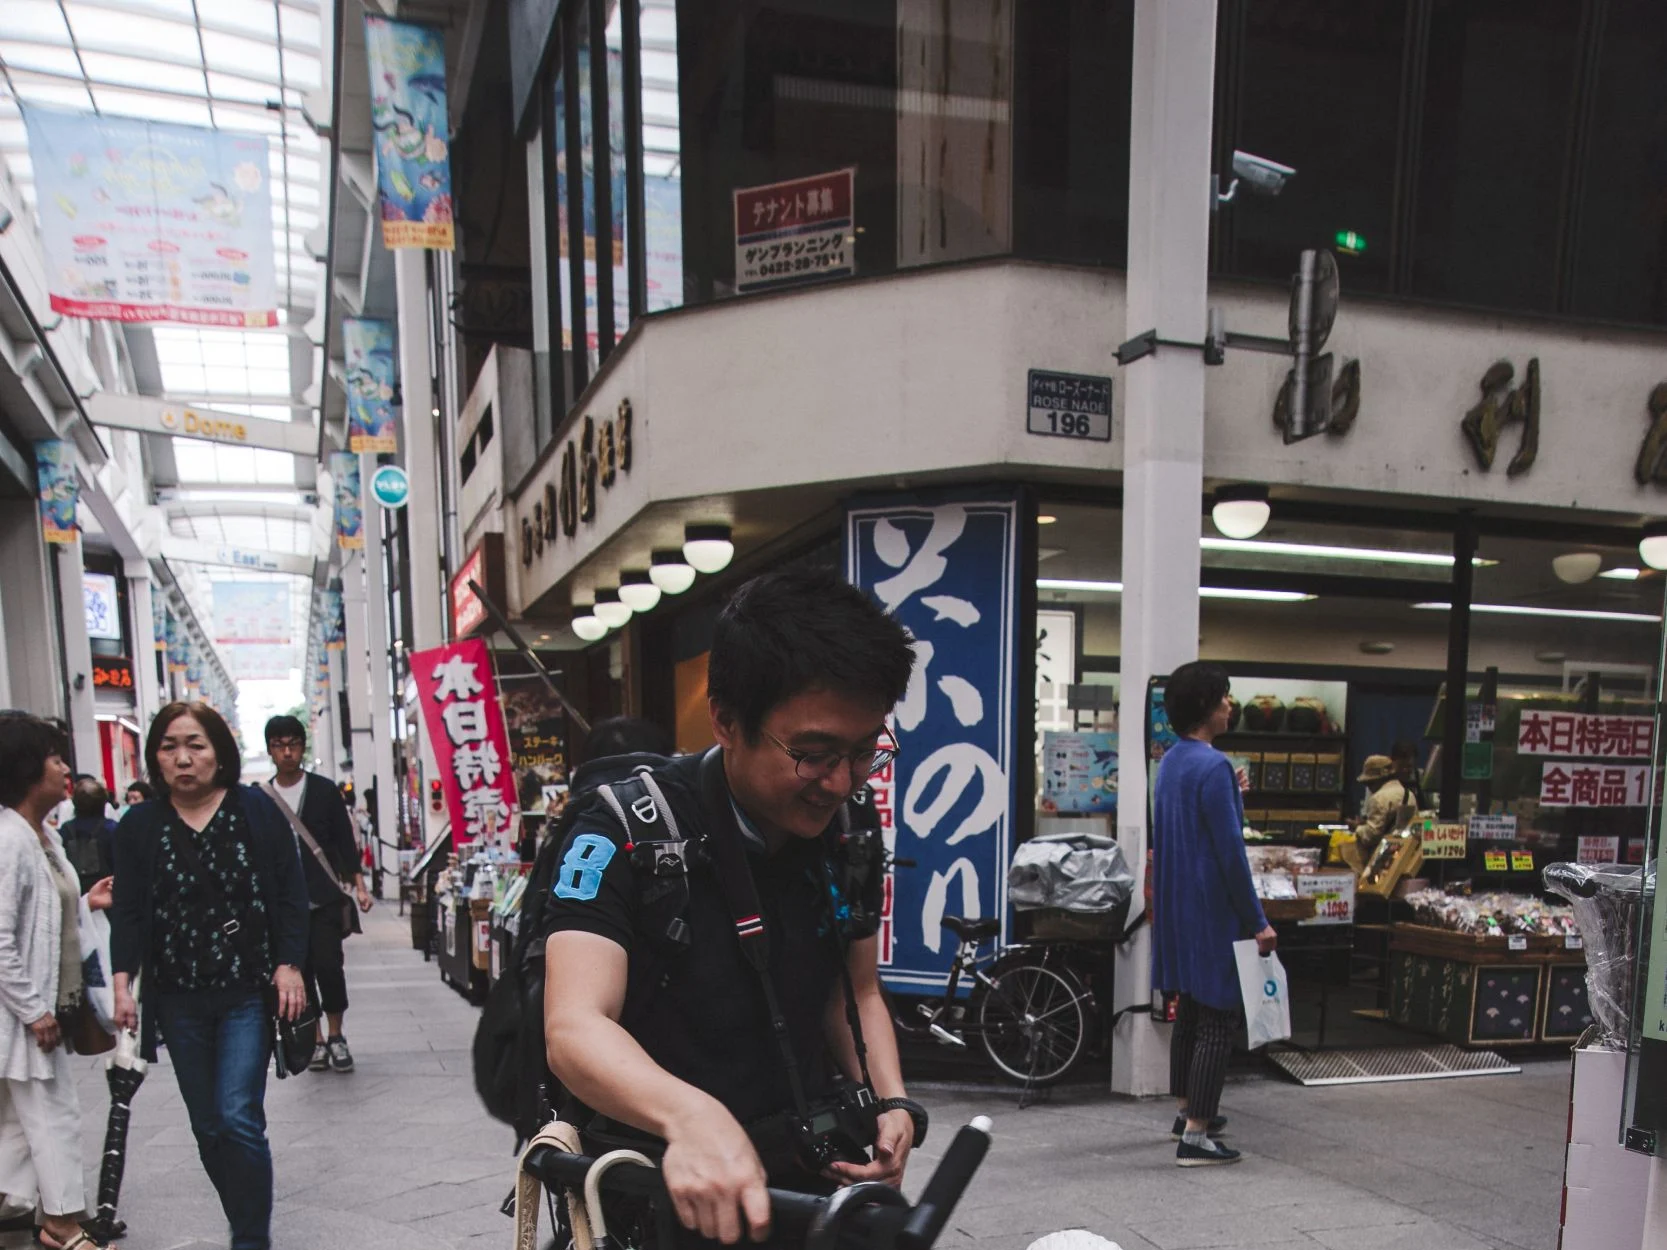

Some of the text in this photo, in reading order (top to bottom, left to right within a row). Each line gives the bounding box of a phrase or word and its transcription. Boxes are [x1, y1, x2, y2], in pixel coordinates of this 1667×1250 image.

[1034, 395, 1105, 413] ROSE NADE
[184, 411, 247, 440] Dome
[1047, 411, 1090, 436] 196
[1519, 713, 1655, 757] 本日特売日
[554, 834, 616, 900] 8
